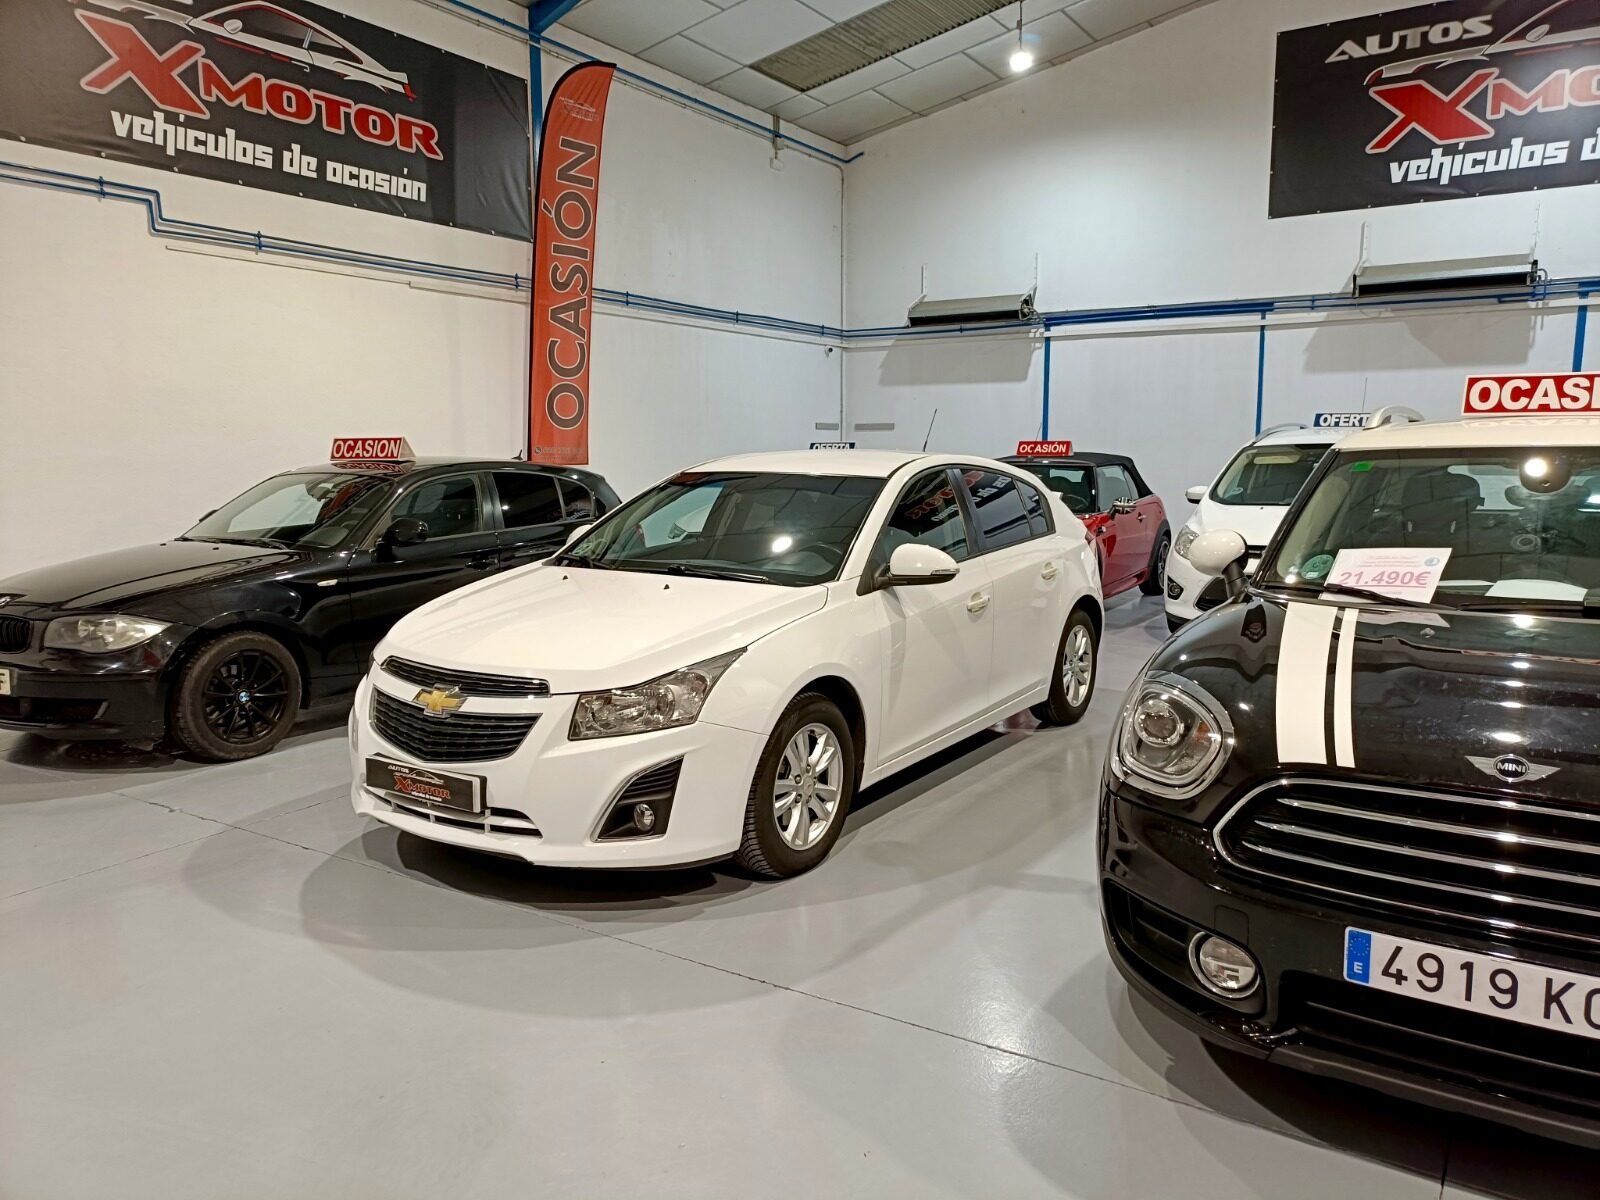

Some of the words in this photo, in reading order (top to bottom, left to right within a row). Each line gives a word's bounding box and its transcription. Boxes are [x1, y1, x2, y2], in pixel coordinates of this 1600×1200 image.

[1325, 14, 1494, 63] AUTOS
[283, 143, 318, 179] de
[326, 160, 427, 203] ocasión
[541, 135, 598, 431] OCASIÓN
[333, 440, 400, 458] OCASION
[1020, 442, 1067, 453] OCASIÓN
[1339, 570, 1431, 586] 21.490€
[1497, 762, 1526, 773] MINI
[1353, 962, 1363, 974] E
[1381, 945, 1519, 1010] 4919
